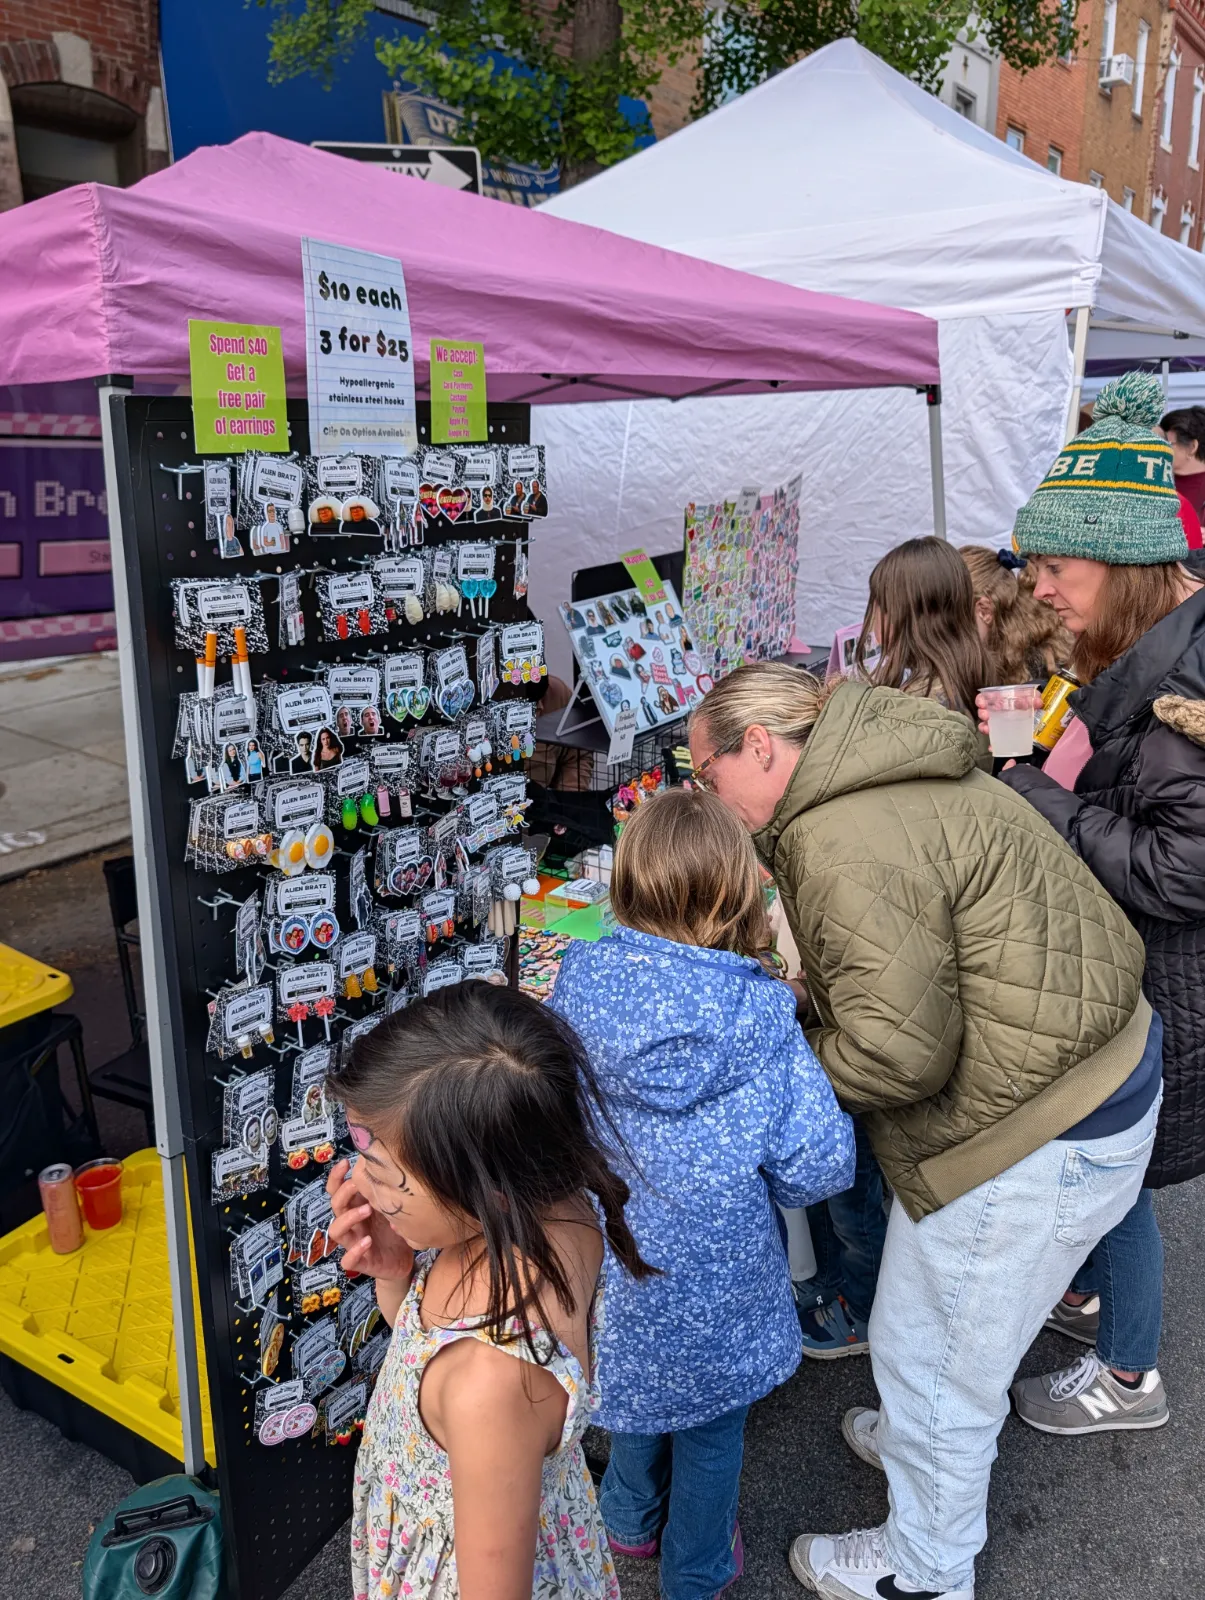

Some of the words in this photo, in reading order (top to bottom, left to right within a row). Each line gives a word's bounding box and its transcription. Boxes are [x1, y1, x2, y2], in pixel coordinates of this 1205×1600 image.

[318, 271, 350, 301] $10
[356, 286, 402, 311] each
[210, 334, 245, 356] Spend
[248, 338, 268, 356] $40
[320, 330, 332, 354] 3
[338, 326, 370, 353] for
[376, 329, 408, 362] $25
[436, 346, 448, 362] We
[227, 363, 245, 380] Get
[248, 366, 255, 381] a
[340, 376, 395, 390] Hypoallergenic
[218, 390, 241, 408] free
[245, 391, 266, 410] pair
[329, 394, 363, 403] stainless
[365, 394, 383, 404] steel
[384, 396, 404, 406] hooks
[216, 417, 226, 434] of
[230, 416, 275, 436] earrings
[323, 426, 338, 438] Clip
[340, 428, 350, 436] On
[352, 428, 376, 437] Option
[261, 468, 276, 477] ALIEN
[278, 471, 297, 481] BRATZ
[304, 696, 323, 705] BRATZ
[300, 792, 318, 800] BRATZ
[232, 1007, 247, 1015] ALIEN
[223, 1154, 240, 1165] ALIEN
